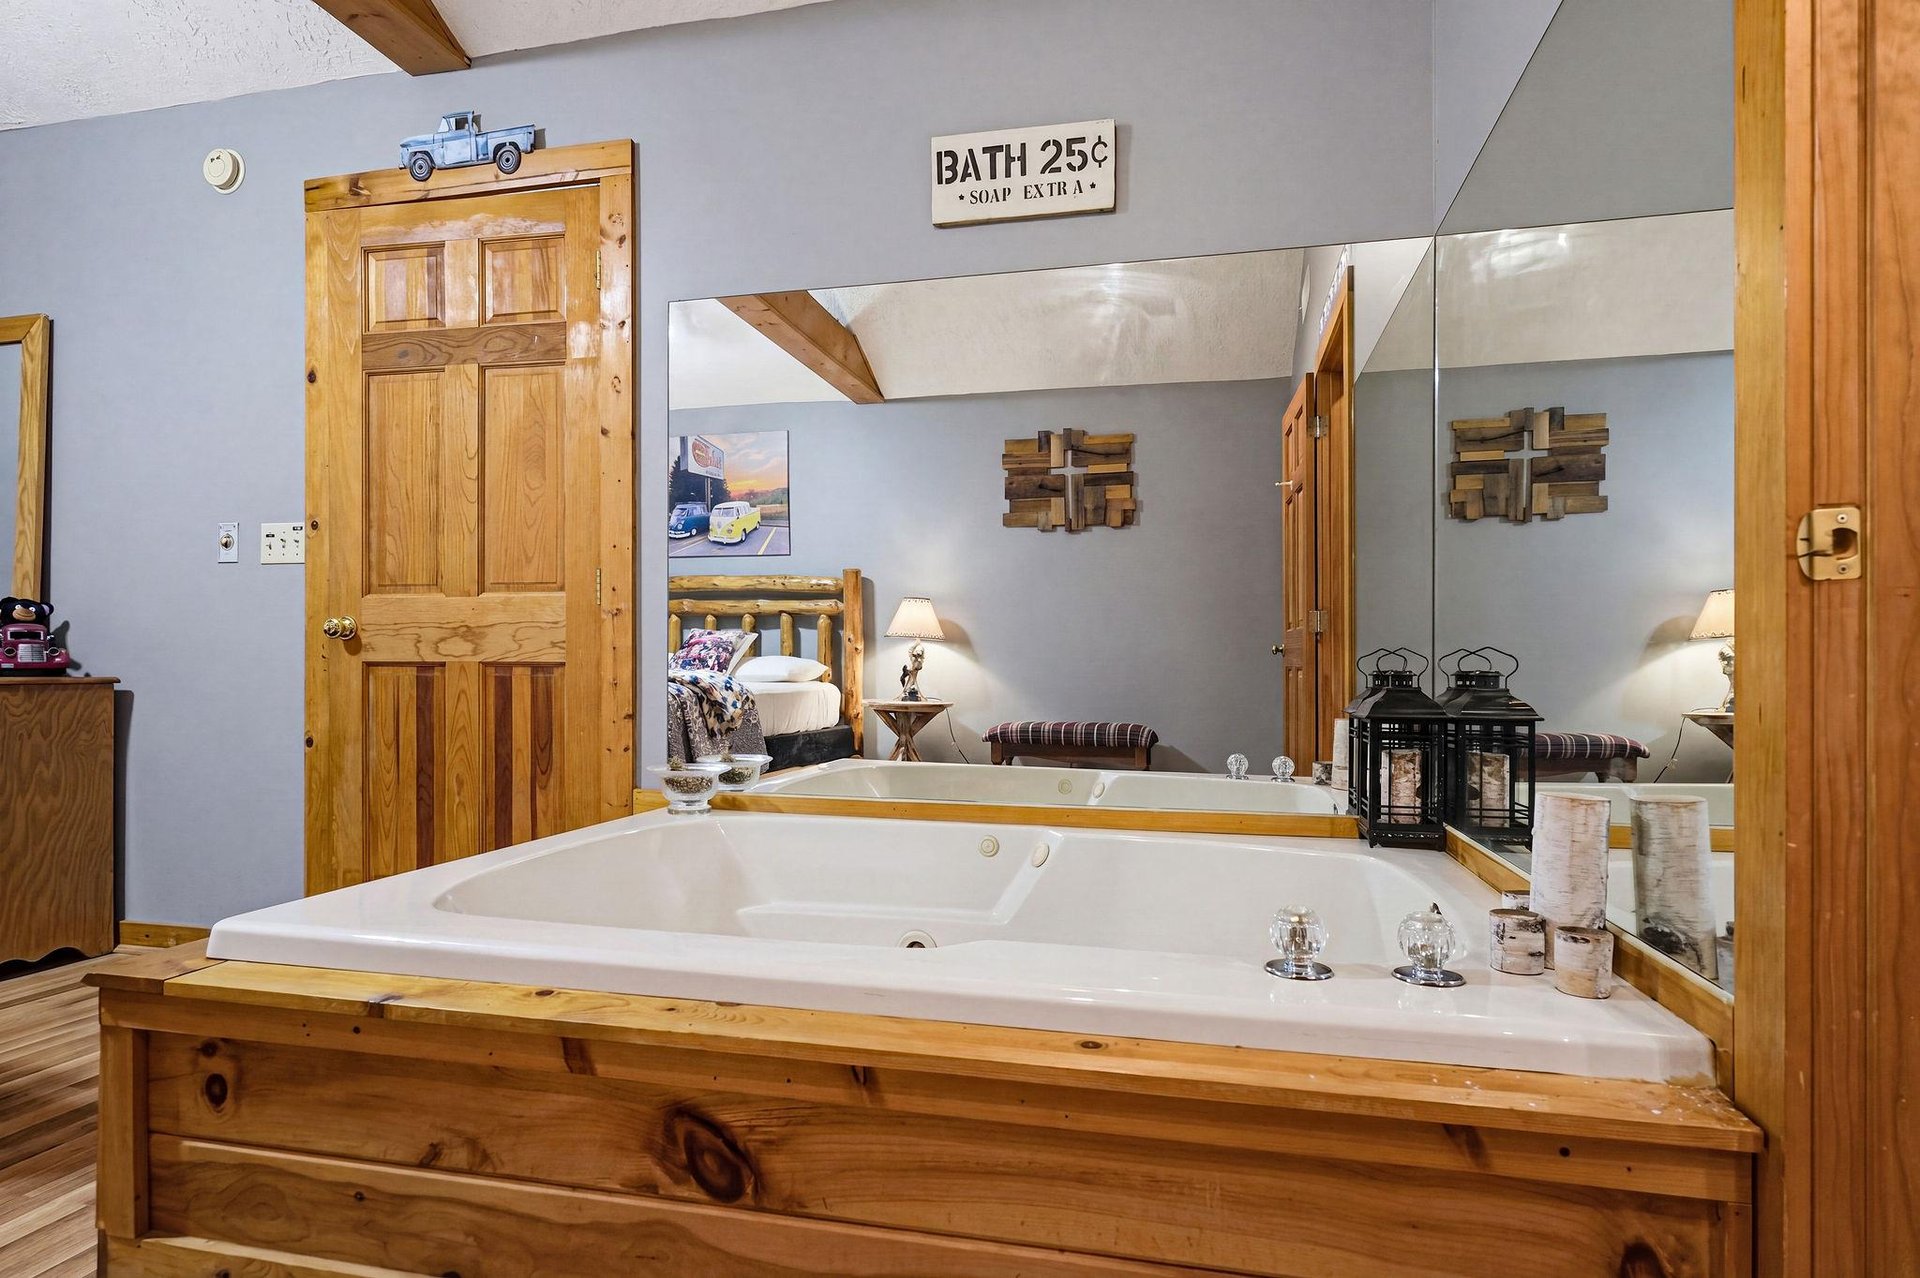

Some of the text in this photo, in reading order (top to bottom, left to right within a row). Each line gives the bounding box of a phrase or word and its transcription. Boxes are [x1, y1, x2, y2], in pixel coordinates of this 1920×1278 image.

[936, 135, 1108, 185] BATH 25¢
[969, 187, 1012, 205] SOAP
